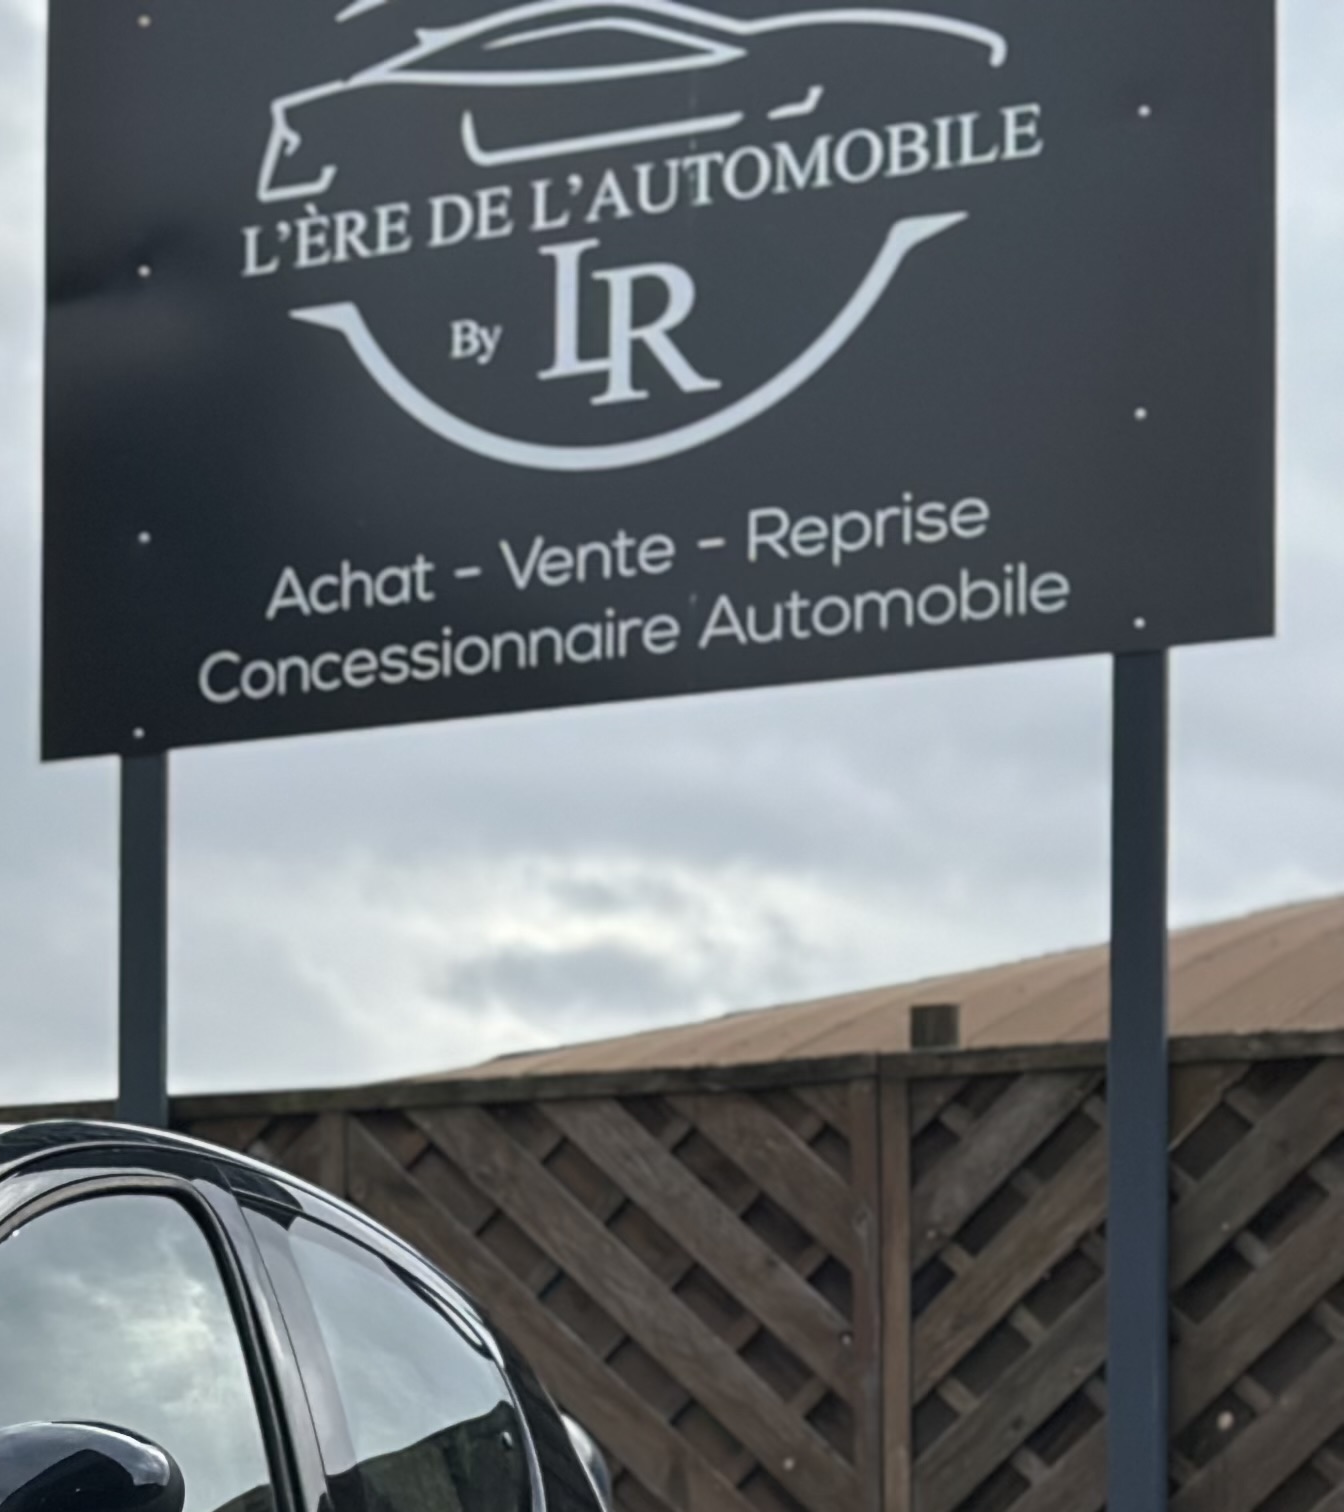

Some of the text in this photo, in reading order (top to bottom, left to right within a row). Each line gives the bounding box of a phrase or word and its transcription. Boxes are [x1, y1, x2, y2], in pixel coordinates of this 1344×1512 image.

[242, 102, 1045, 278] L'ÈRE DE L'AUTOMOBILE
[450, 236, 723, 407] By LR
[198, 561, 1072, 704] Concessionnaire Automobile
[266, 554, 436, 620] Achat
[499, 530, 677, 591] Vente
[746, 491, 992, 568] Reprise
